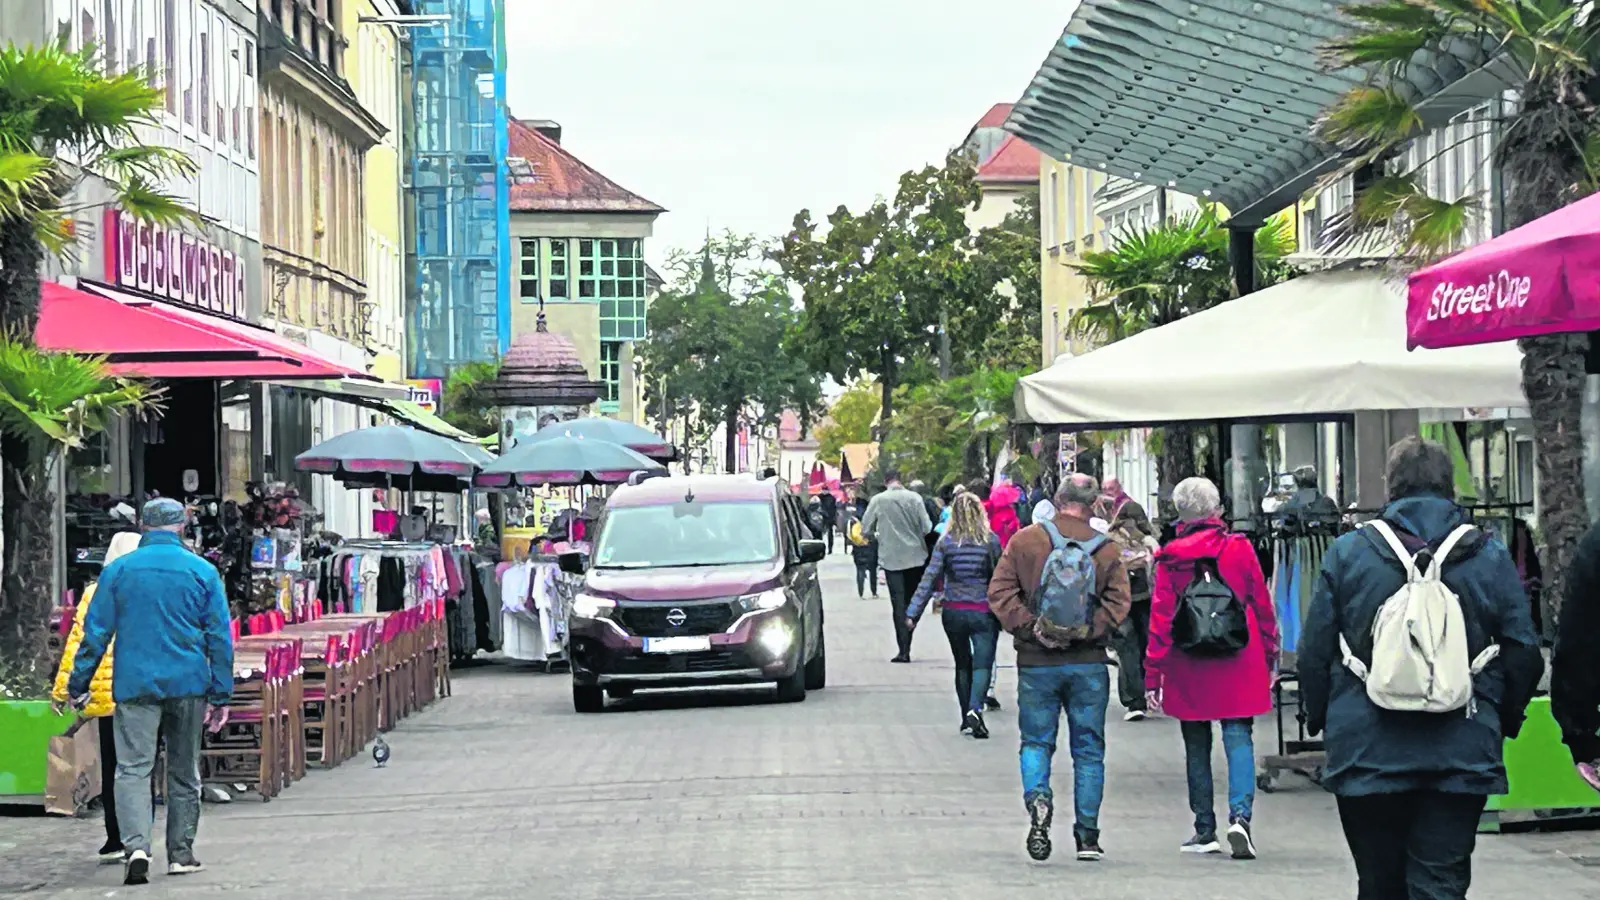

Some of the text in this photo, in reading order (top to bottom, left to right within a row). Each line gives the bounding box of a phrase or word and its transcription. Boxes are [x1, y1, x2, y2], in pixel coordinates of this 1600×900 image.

[119, 209, 246, 317] WOOLWORTH
[1427, 269, 1531, 321] Street One
